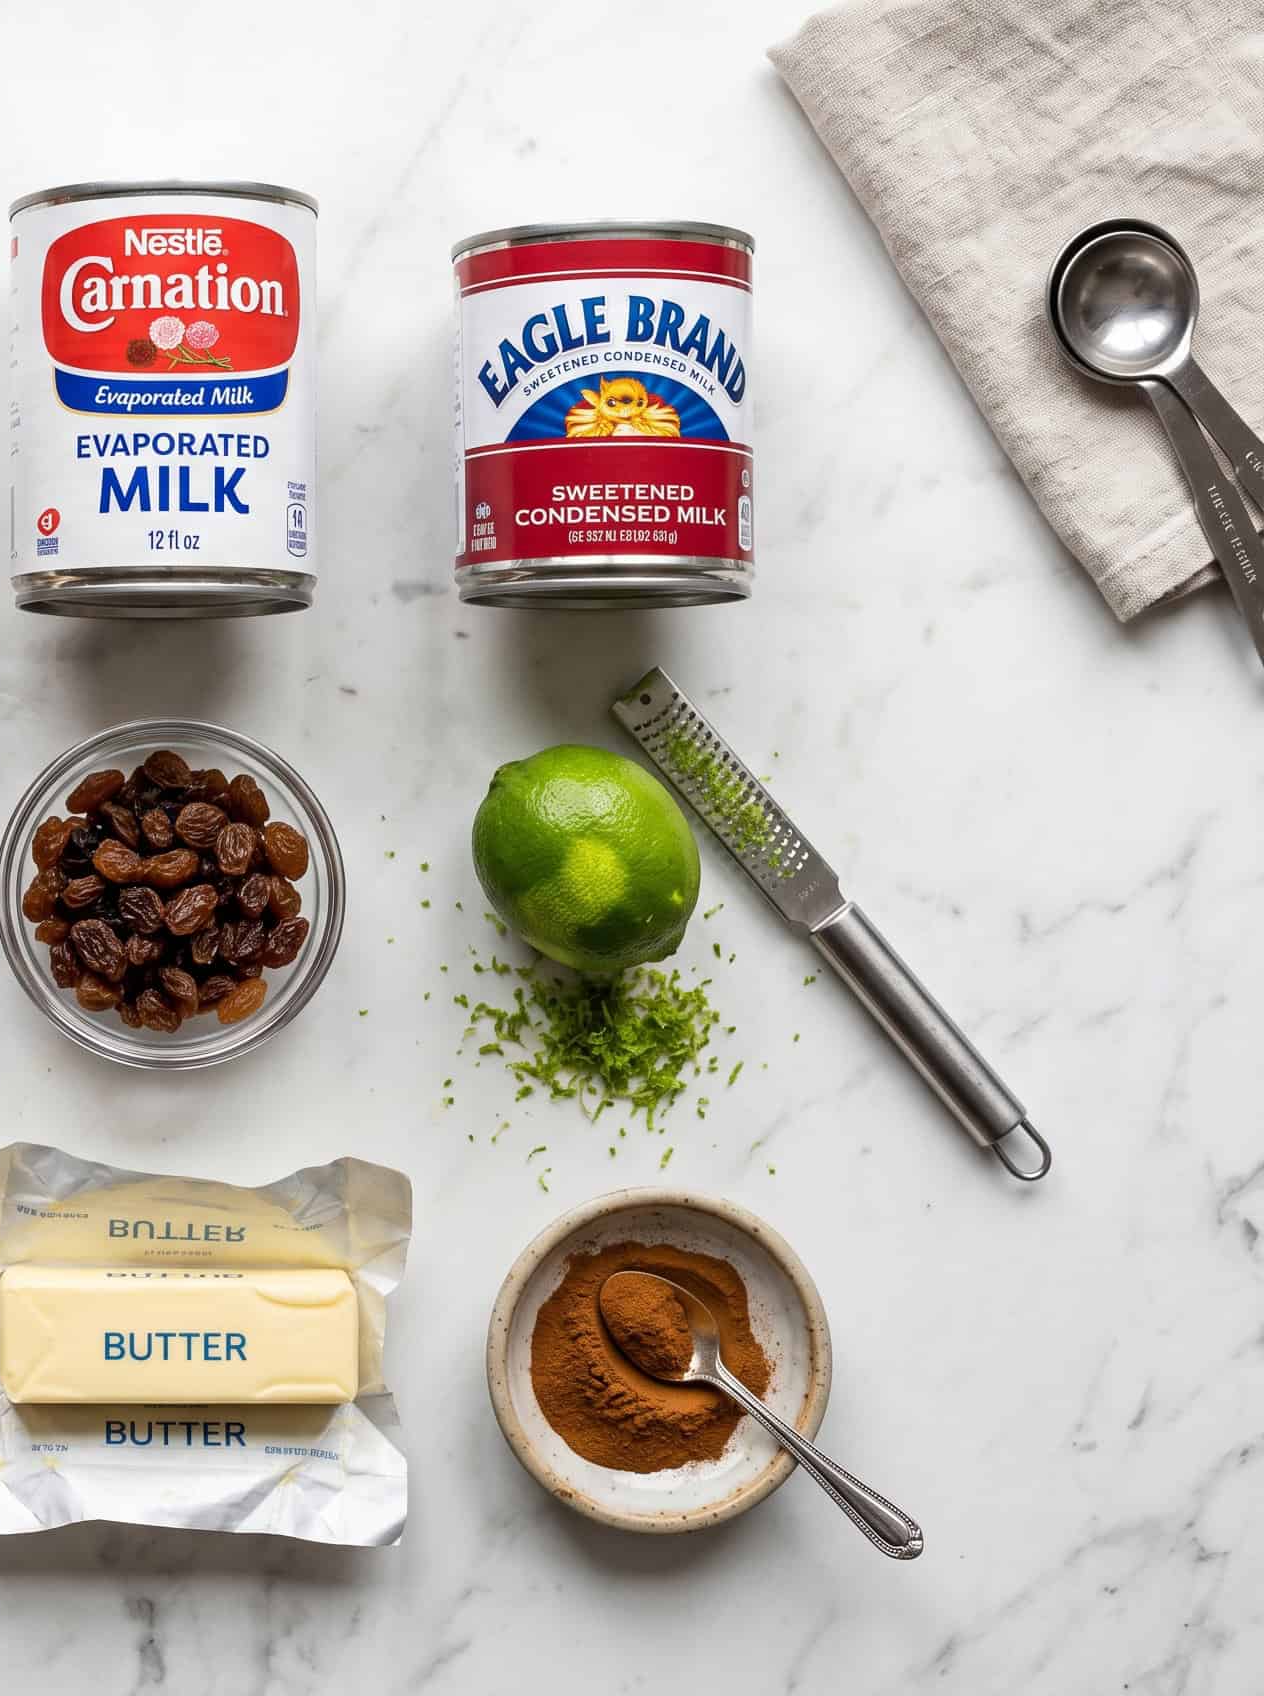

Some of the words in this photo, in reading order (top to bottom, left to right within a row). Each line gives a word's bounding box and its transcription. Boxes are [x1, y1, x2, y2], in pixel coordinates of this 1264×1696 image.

[125, 228, 222, 257] Nestlé
[59, 255, 285, 332] Carnation
[478, 295, 610, 409] EAGLE
[625, 295, 747, 405] BRAND
[523, 353, 599, 397] SWEETENED
[604, 351, 687, 373] CONDENSED
[689, 368, 717, 396] MILK
[94, 385, 205, 411] Evaporated
[210, 386, 254, 405] Milk
[76, 432, 270, 459] EVAPORATED
[98, 465, 250, 514] MILK
[552, 484, 695, 502] SWEETENED
[515, 505, 670, 527] CONDENSED
[677, 506, 727, 526] MILK
[148, 531, 165, 550] 12
[168, 530, 181, 550] fl
[183, 533, 200, 550] oz
[103, 1331, 247, 1361] BUTTER
[104, 1419, 247, 1447] BUTTER
